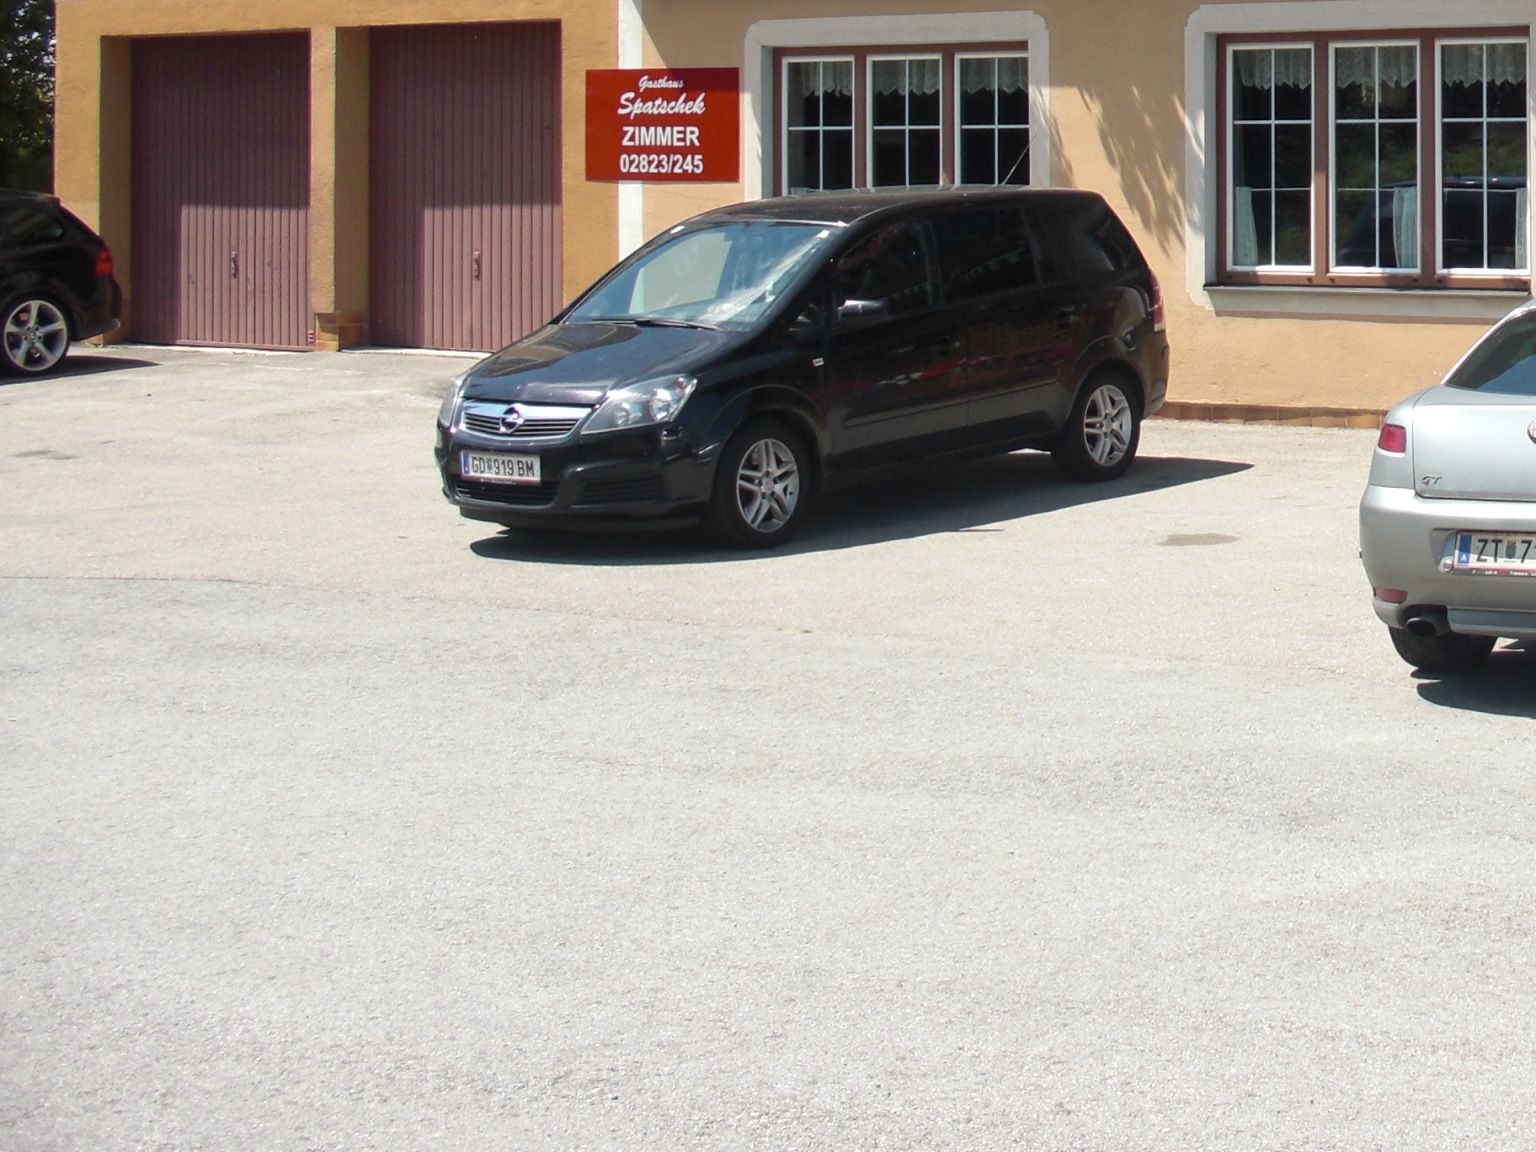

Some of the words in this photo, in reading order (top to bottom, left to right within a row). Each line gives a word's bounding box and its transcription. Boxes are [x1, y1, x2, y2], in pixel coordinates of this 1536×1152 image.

[638, 75, 684, 92] Gasthaus
[617, 91, 706, 120] Spatschek
[621, 126, 700, 147] ZIMMER
[619, 153, 704, 174] 02823/245
[471, 456, 485, 474] GD
[493, 459, 514, 476] 919
[517, 460, 535, 478] BM
[1476, 538, 1503, 563] ZT
